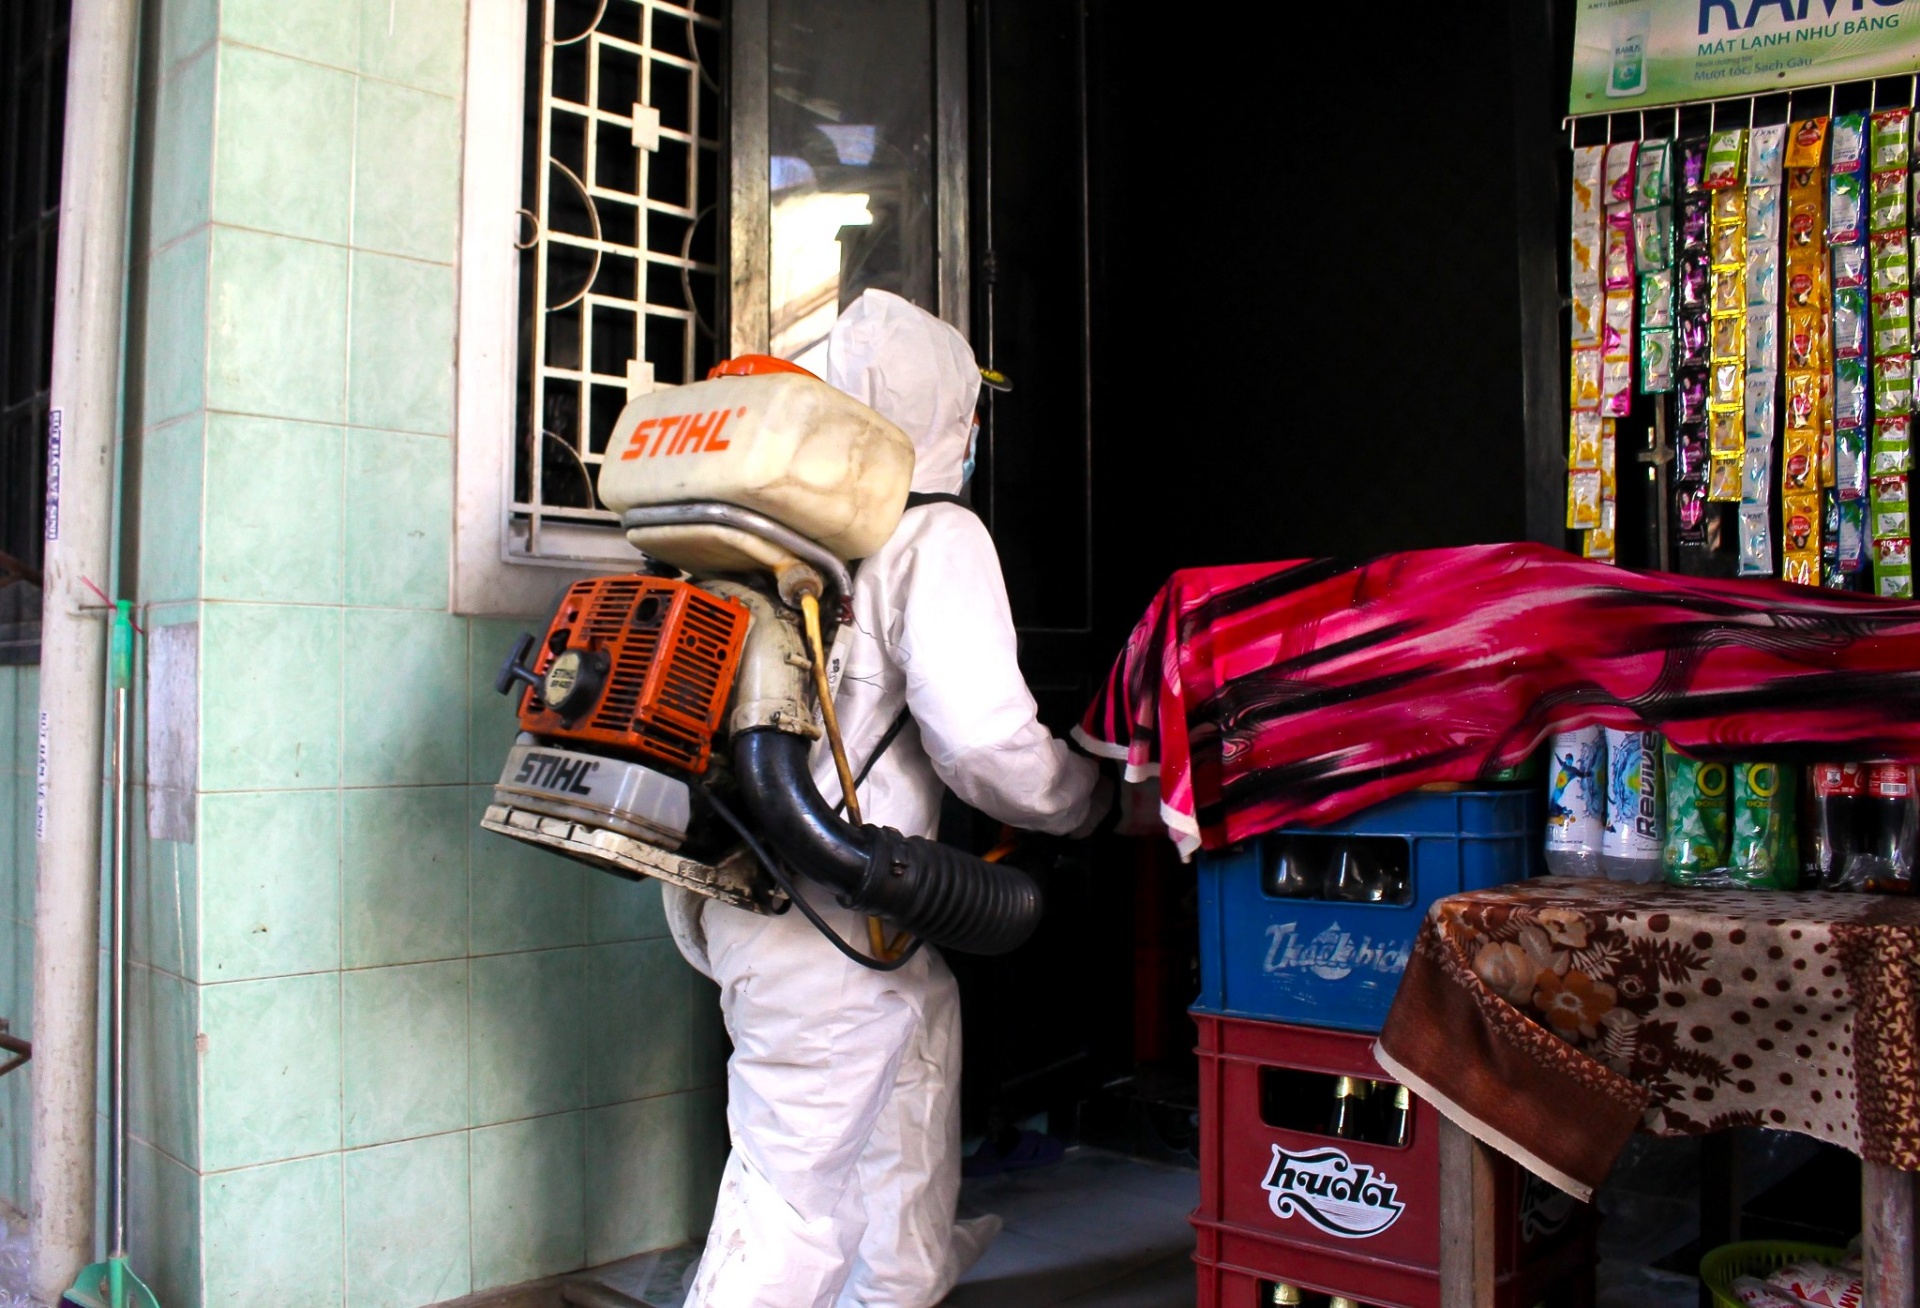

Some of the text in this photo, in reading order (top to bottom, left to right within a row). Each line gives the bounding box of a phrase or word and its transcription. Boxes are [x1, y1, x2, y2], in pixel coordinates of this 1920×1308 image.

[1698, 14, 1900, 57] MÁT LẠNH NHƯ BĂNG
[1753, 128, 1778, 138] Dove
[621, 408, 732, 461] STIHL
[515, 753, 592, 796] STIHL
